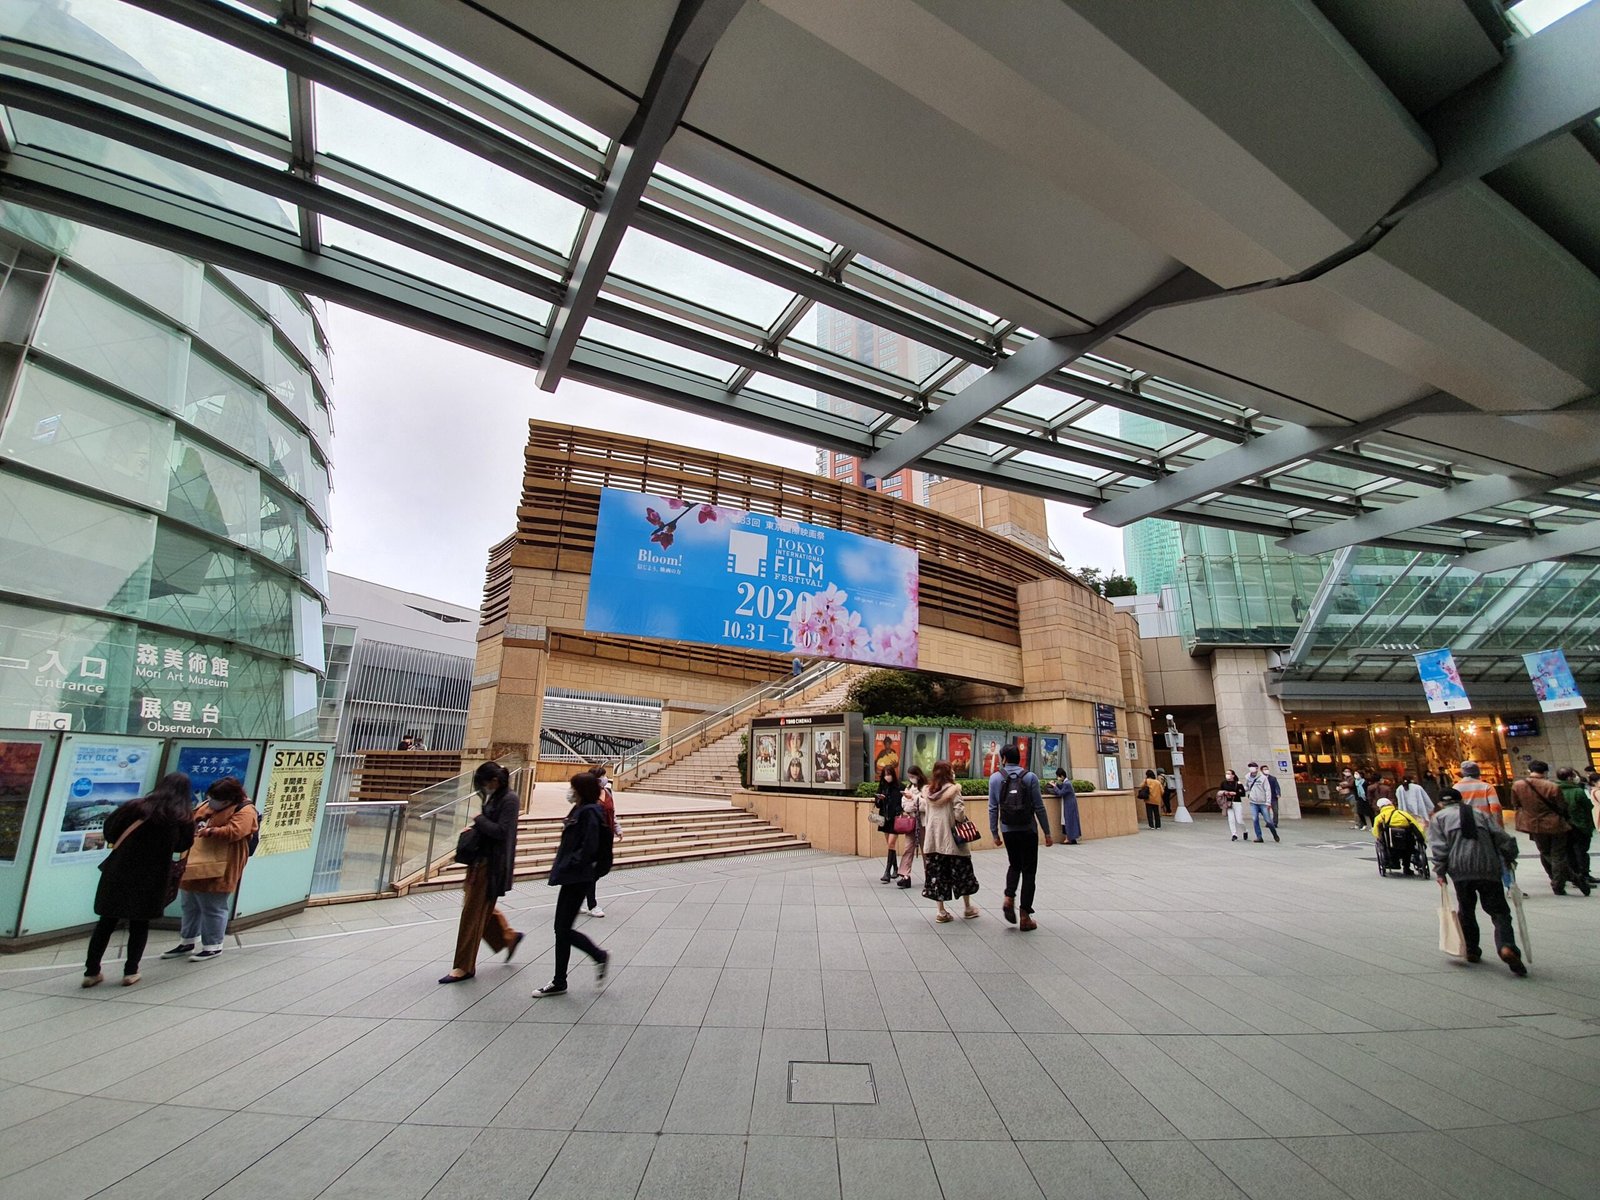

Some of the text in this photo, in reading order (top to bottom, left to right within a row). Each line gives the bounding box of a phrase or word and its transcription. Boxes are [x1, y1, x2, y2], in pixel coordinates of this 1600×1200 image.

[734, 516, 761, 528] 33回
[775, 549, 824, 563] INTERNATIONAL
[776, 537, 825, 557] TOKYO
[638, 548, 683, 567] Bloom!
[774, 555, 824, 580] FILM
[774, 573, 823, 588] FESTIVAL
[735, 581, 815, 624] 2020
[38, 649, 107, 680] 入口
[136, 643, 230, 678] 森美術館
[34, 675, 105, 694] Entrance
[135, 666, 229, 688] Mori Art Museum
[140, 696, 220, 724] 展望台
[147, 721, 214, 738] Observatory
[77, 753, 118, 762] SKY DECK
[199, 756, 230, 764] 六本木
[274, 751, 326, 767] STARS
[191, 764, 234, 774] 天文クラブ
